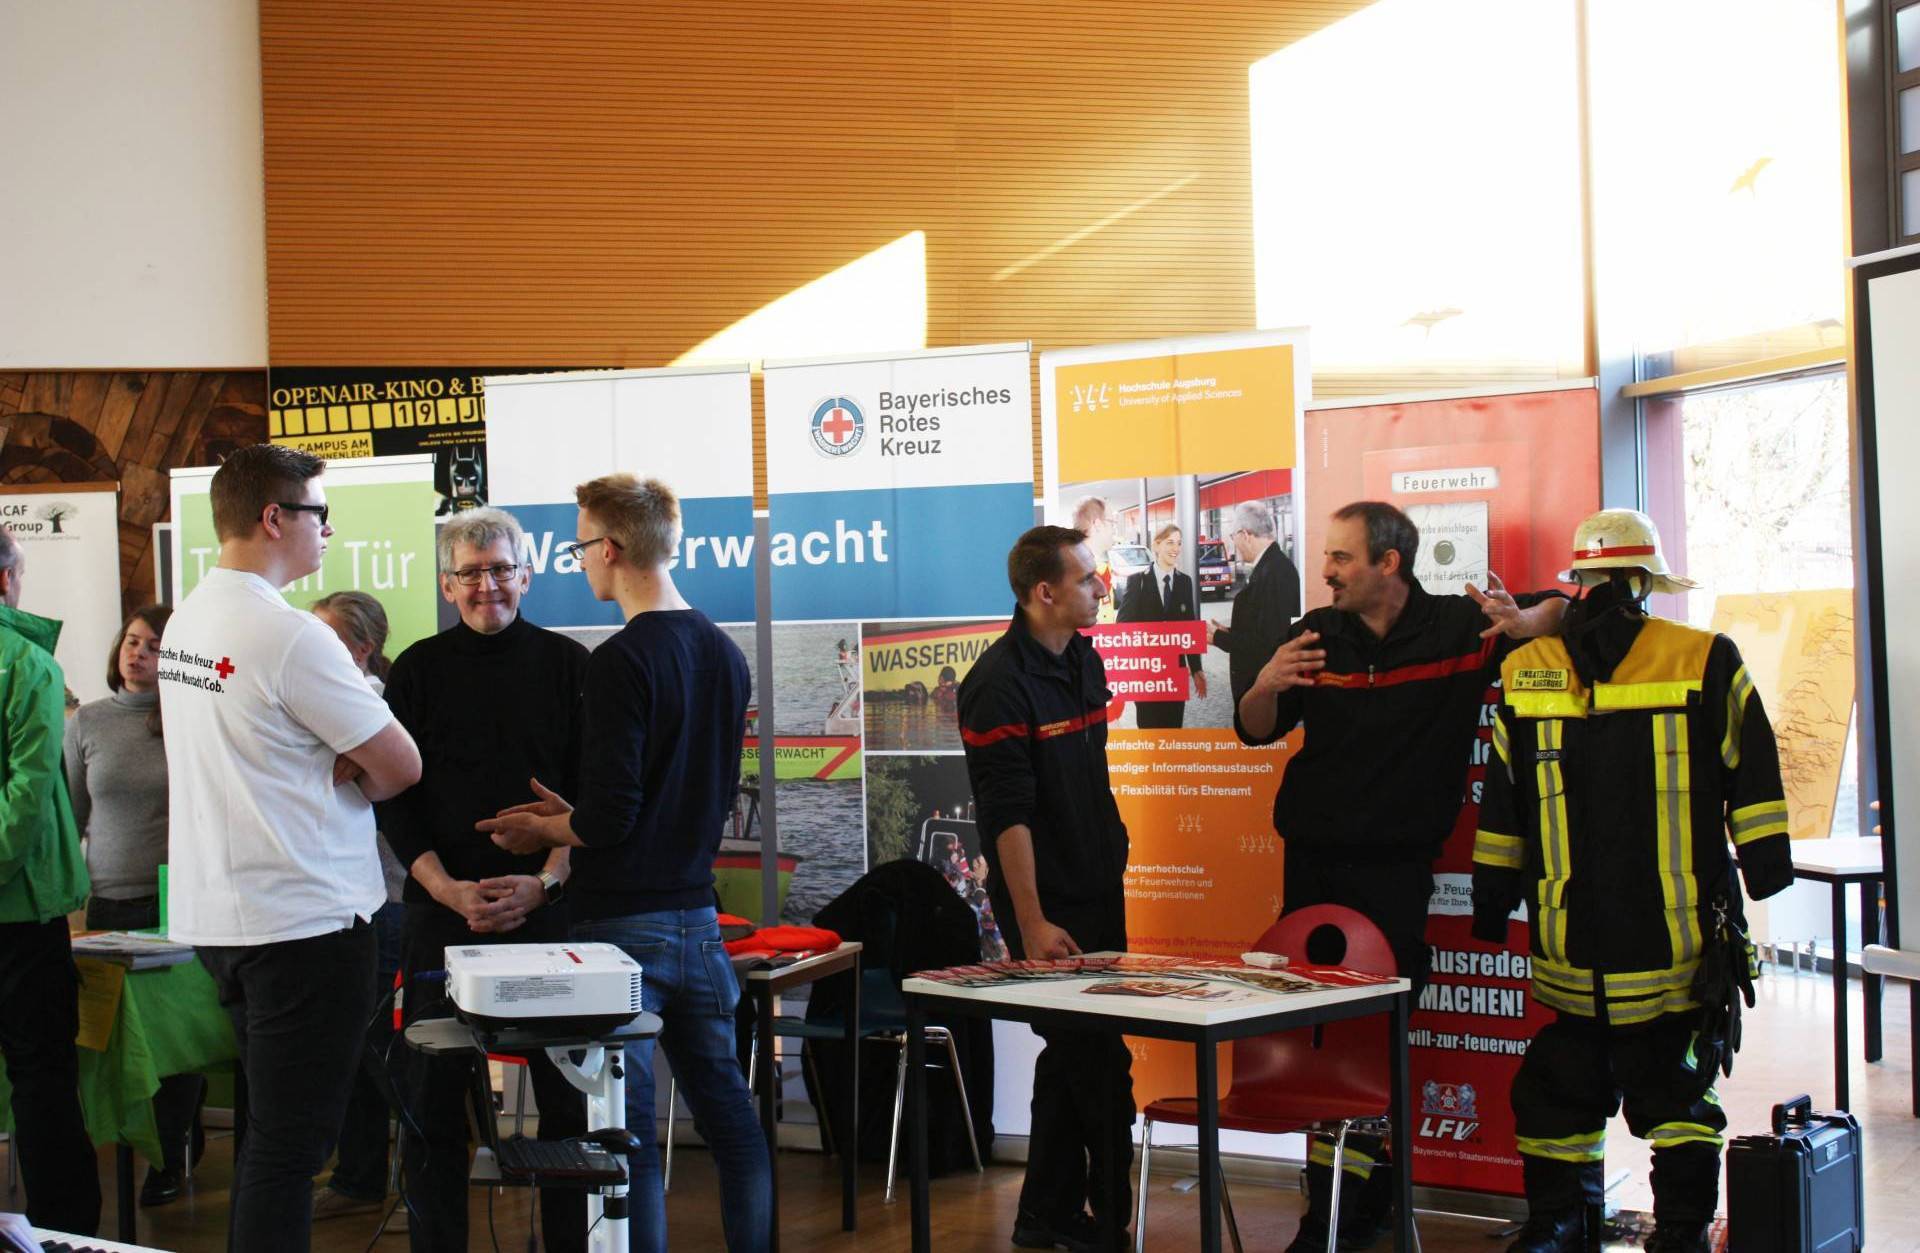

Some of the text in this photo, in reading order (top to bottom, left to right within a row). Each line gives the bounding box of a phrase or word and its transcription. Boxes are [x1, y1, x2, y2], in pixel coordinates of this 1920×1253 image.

[273, 379, 444, 407] OPENAIR-KINO
[449, 377, 466, 396] &
[1119, 381, 1171, 394] Hochschule
[879, 387, 1011, 413] Bayerisches
[1161, 394, 1172, 404] of
[397, 399, 484, 425] 19.J
[880, 415, 940, 434] Rotes
[351, 439, 369, 448] AM
[881, 438, 941, 456] Kreuz
[1403, 473, 1487, 490] Feuerwehr
[344, 540, 415, 591] Tür
[1092, 631, 1196, 649] rtschätzung.
[194, 653, 214, 669] Kreuz
[1103, 655, 1167, 673] etzung.
[1108, 677, 1178, 696] gement.
[1158, 740, 1211, 752] Zulassung
[1215, 742, 1237, 750] zum
[1152, 763, 1272, 774] Informationsaustausch
[1121, 785, 1176, 796] Flexibilität
[1178, 785, 1198, 796] fürs
[1201, 786, 1252, 796] Ehrenamt
[1140, 877, 1195, 887] Feuerwehren
[1197, 879, 1213, 888] und
[1419, 984, 1524, 1018] MACHEN!
[1408, 1029, 1531, 1056] will-zur-feuerwe
[1419, 1117, 1480, 1141] LFV
[1412, 1145, 1524, 1167] Bayerischen Staatsministerium
